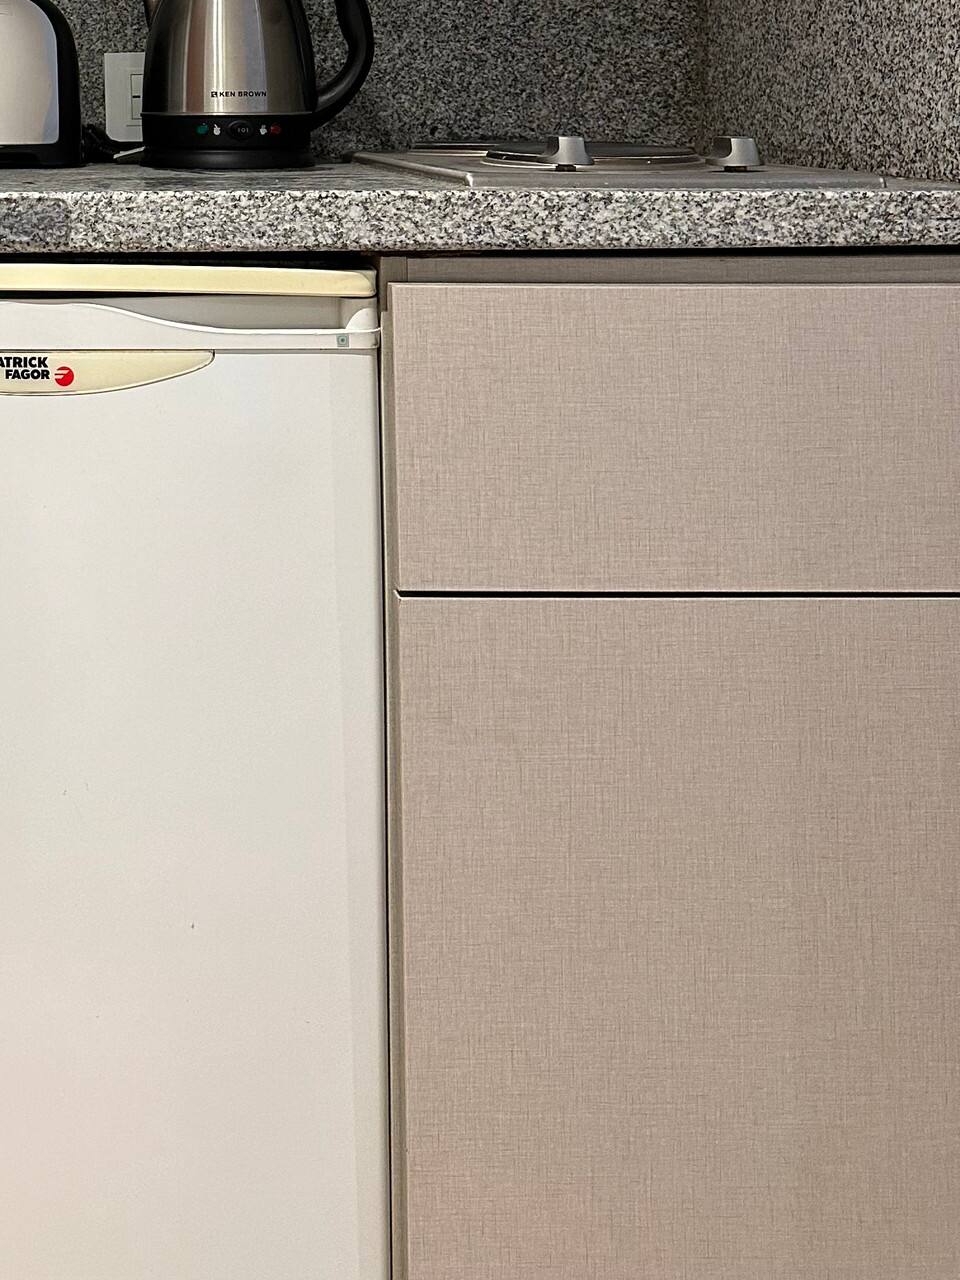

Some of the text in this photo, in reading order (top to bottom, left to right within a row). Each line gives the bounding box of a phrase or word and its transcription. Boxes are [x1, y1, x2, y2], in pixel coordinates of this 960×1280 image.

[219, 90, 267, 98] KEN BROWN
[5, 369, 50, 380] FAGOR
